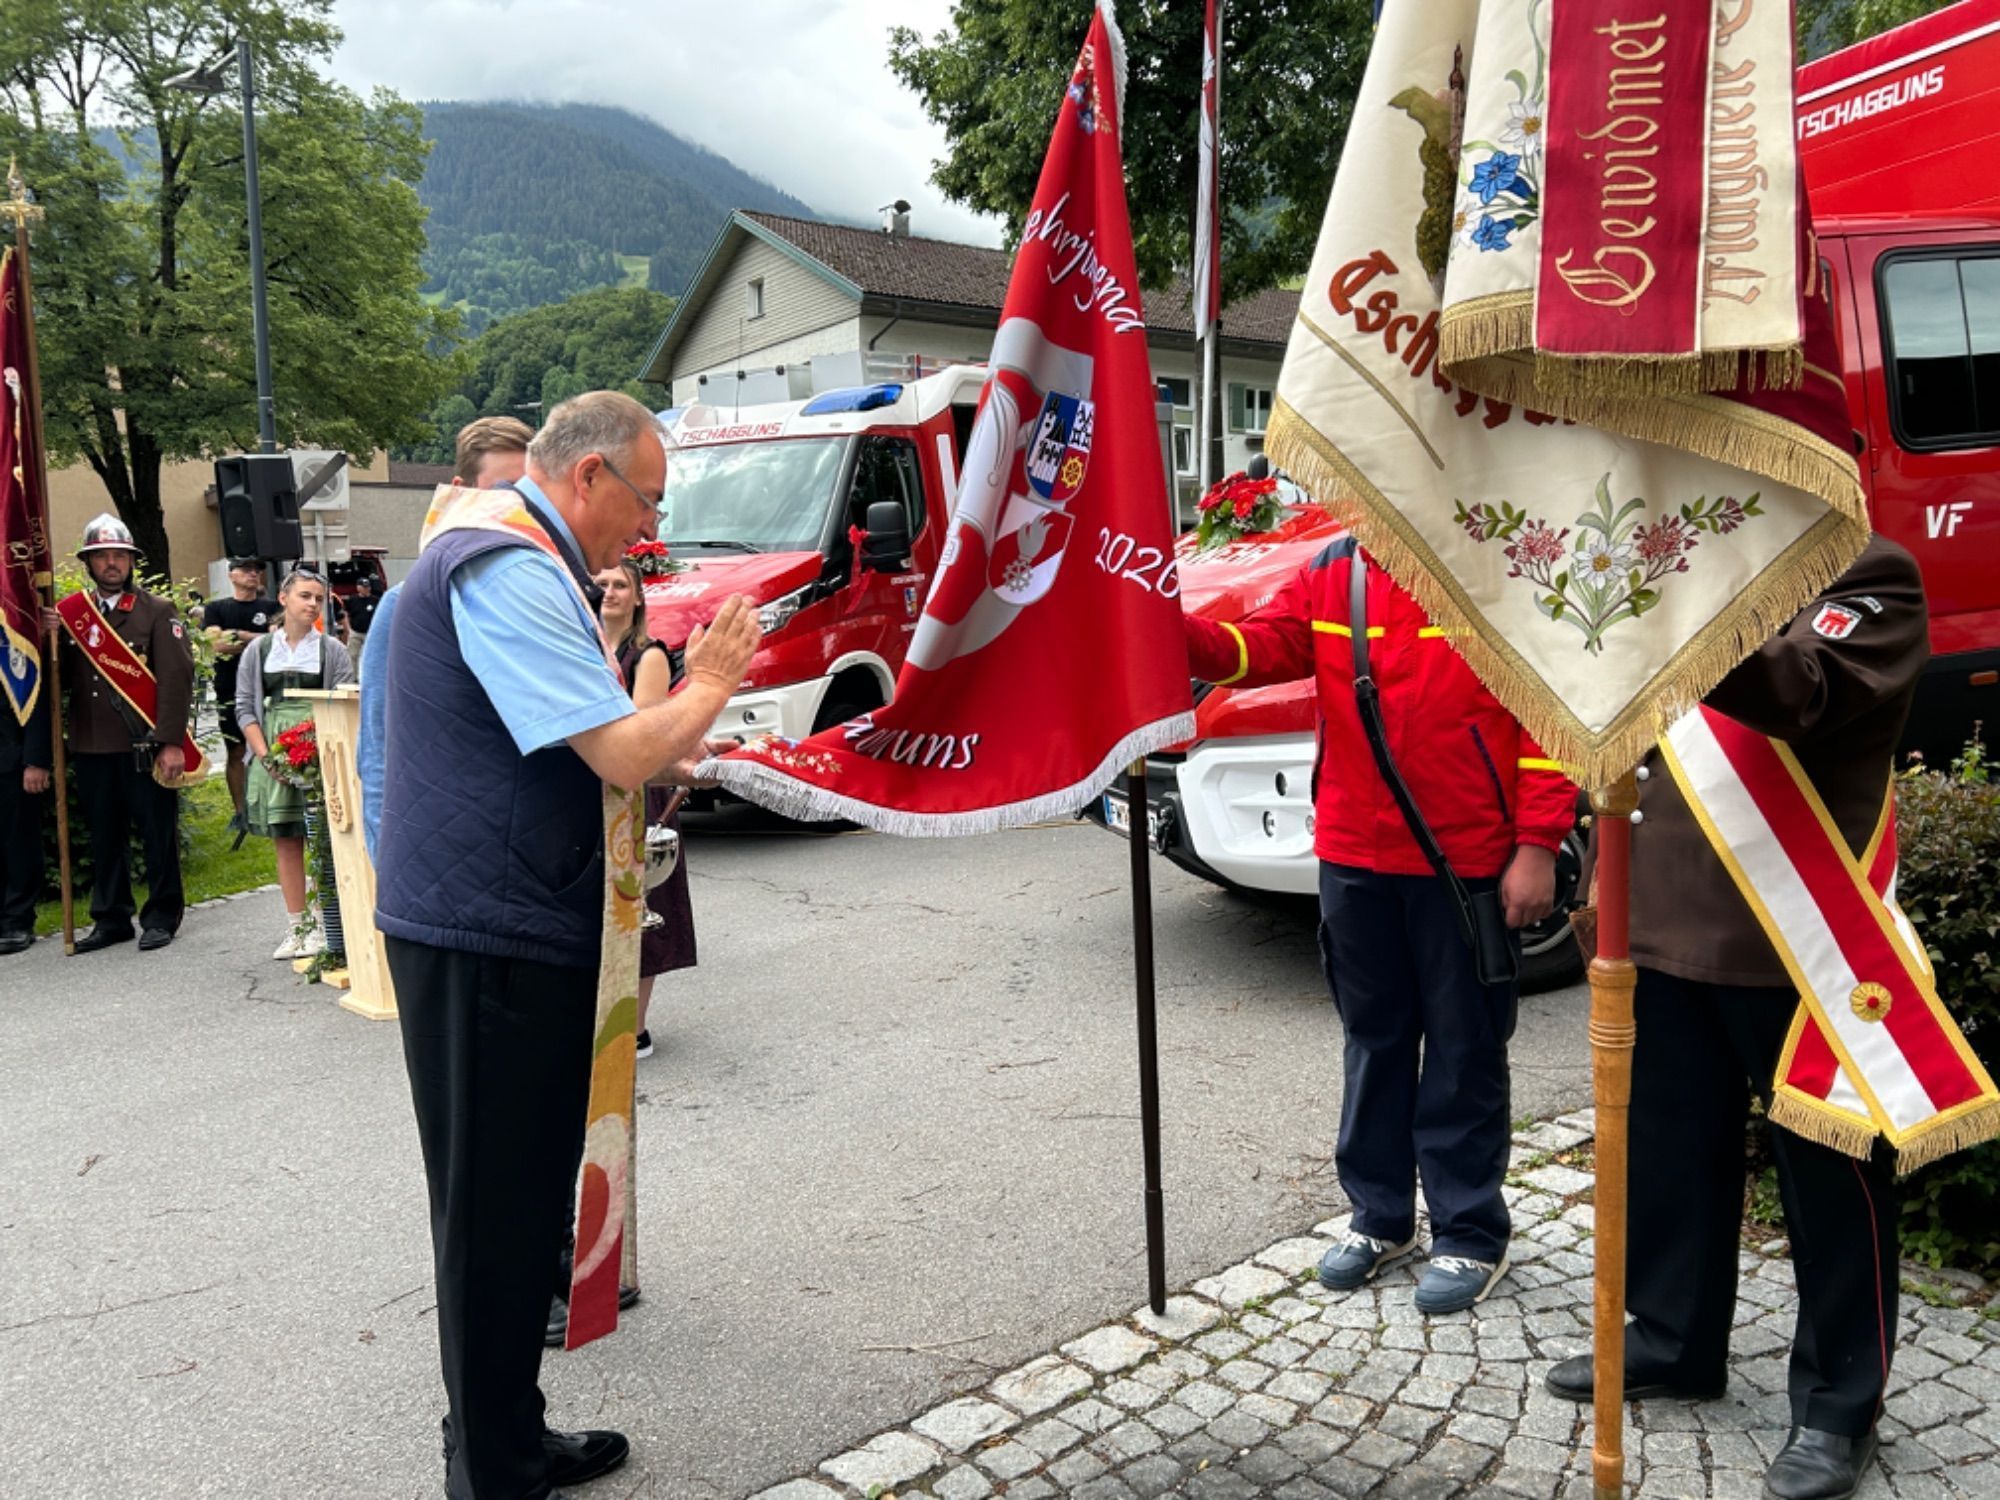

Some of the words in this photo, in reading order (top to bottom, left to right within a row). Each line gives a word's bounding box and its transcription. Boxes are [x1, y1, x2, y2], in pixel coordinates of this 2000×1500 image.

[1798, 65, 1945, 141] TSCHAGGUNS
[1555, 13, 1667, 313] Gewidmet
[680, 422, 783, 443] TSCHAGGUNS
[1926, 501, 1973, 538] VF
